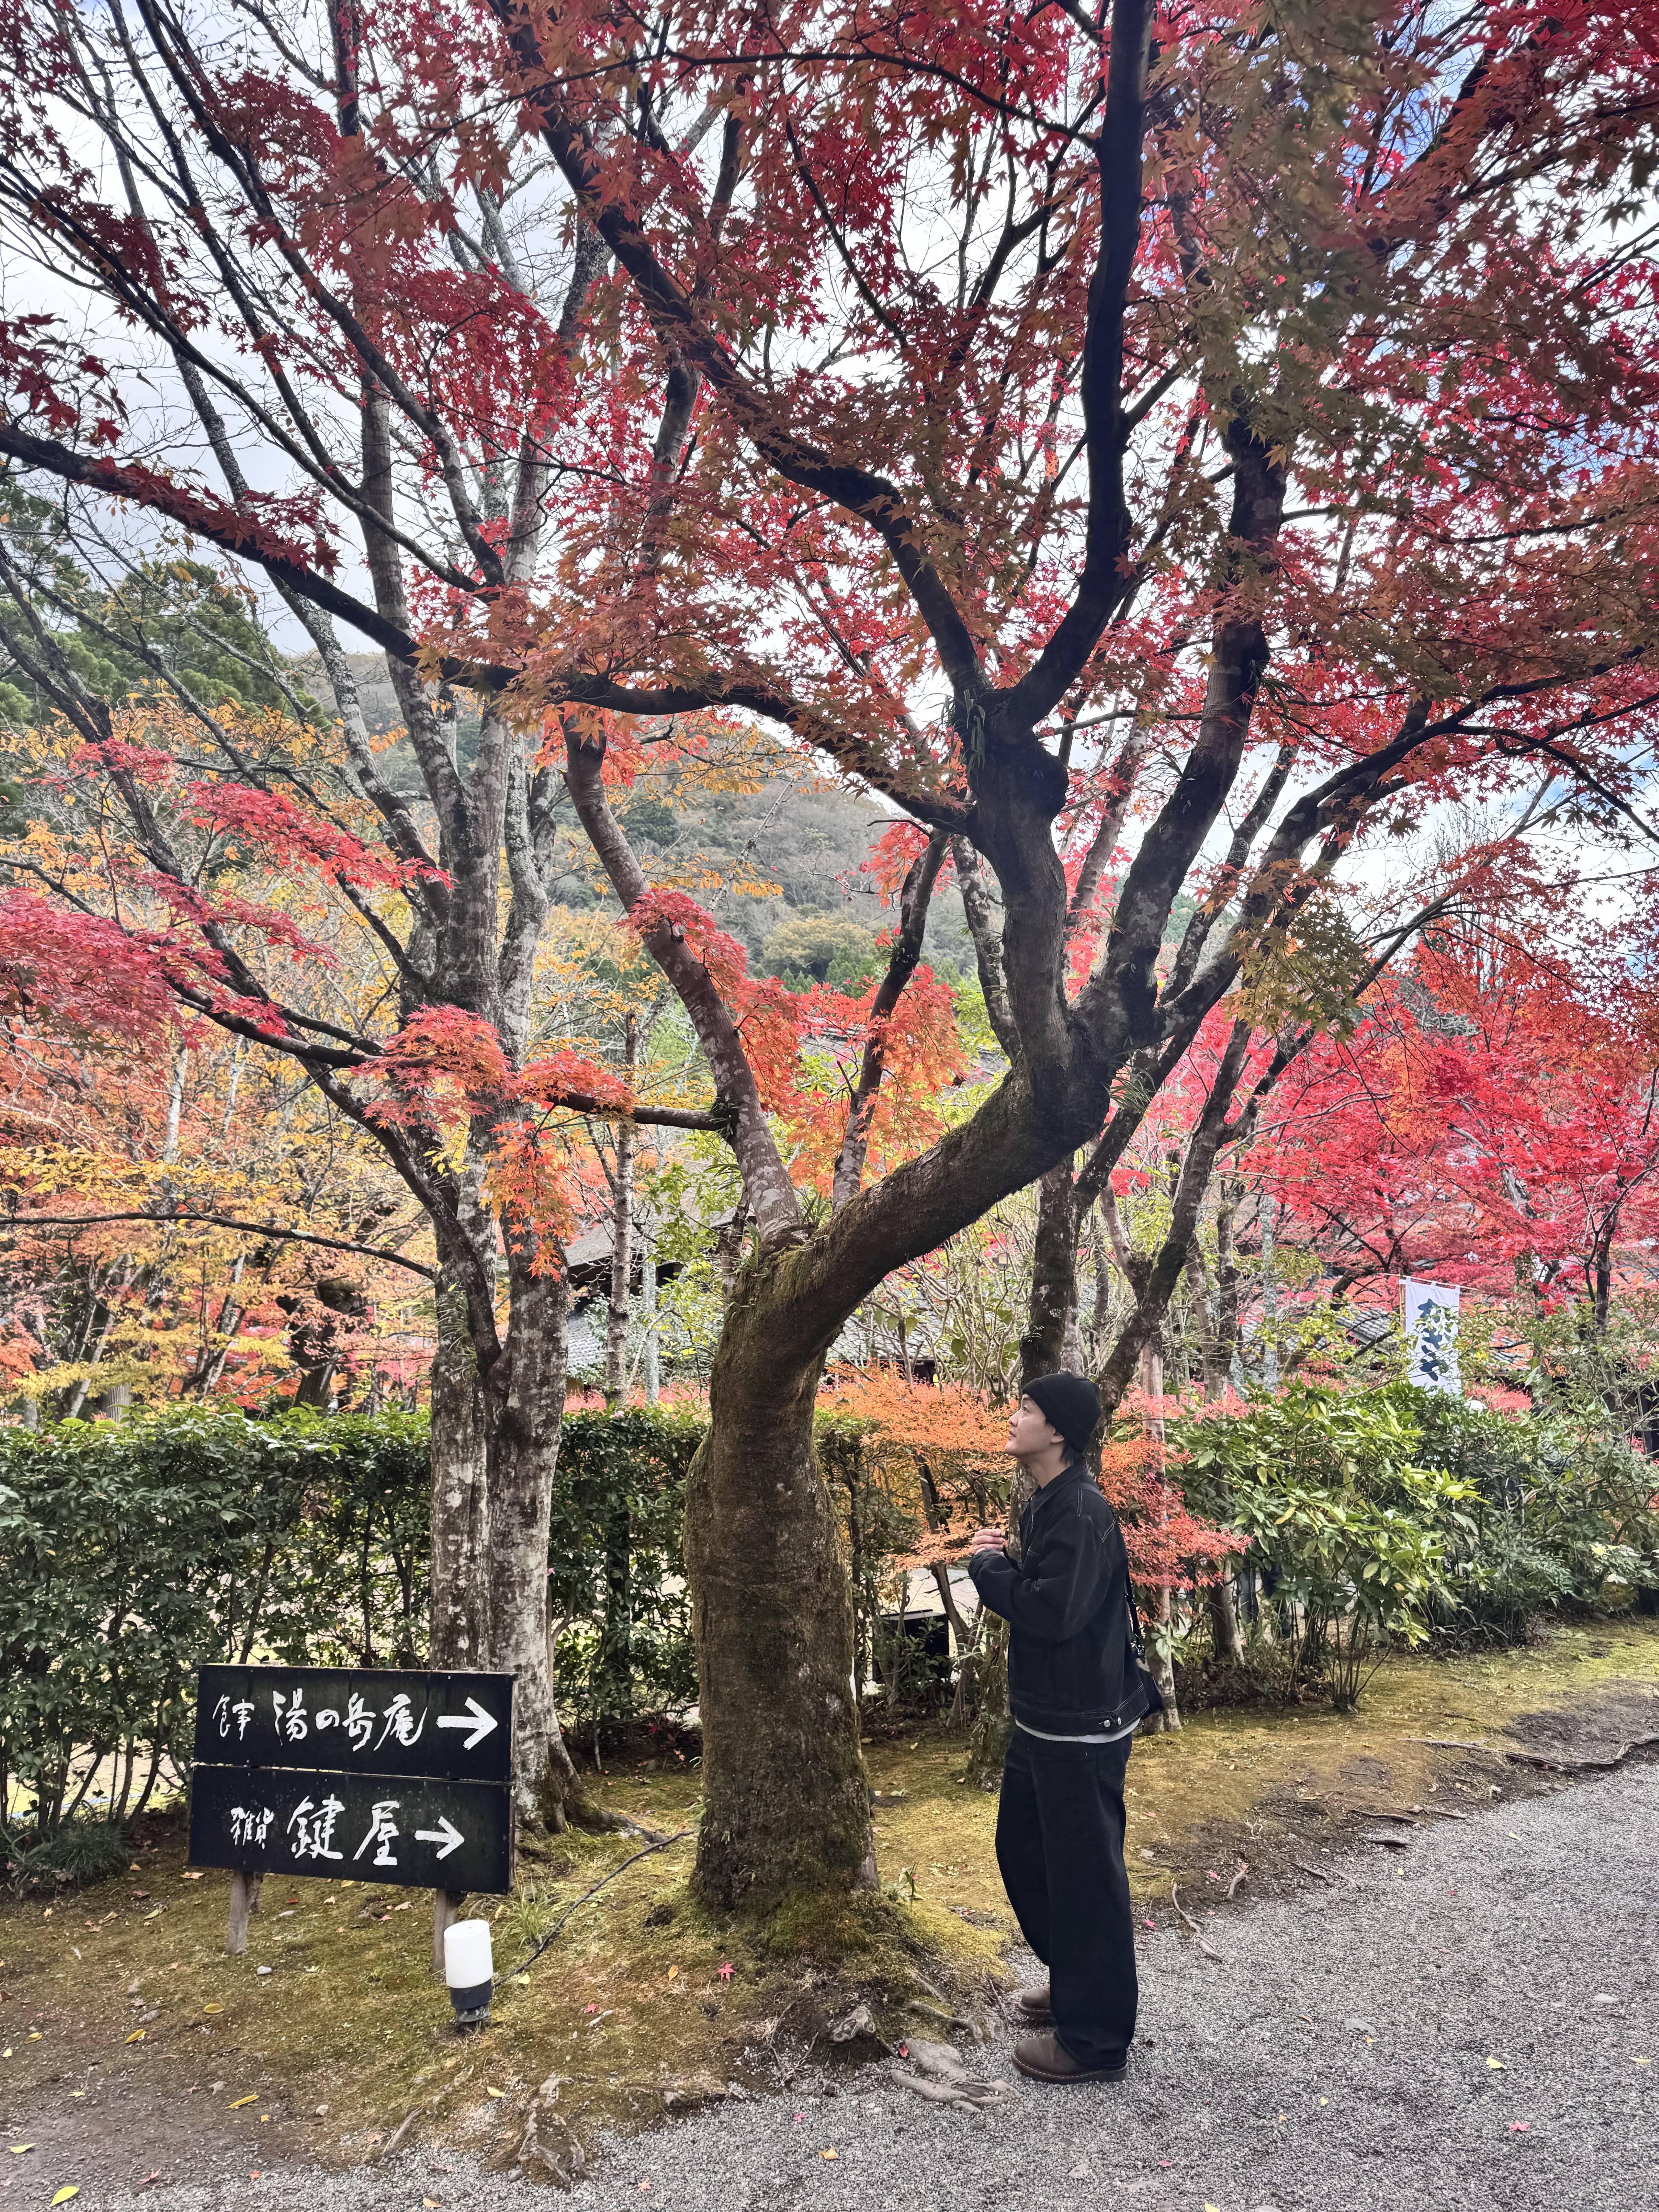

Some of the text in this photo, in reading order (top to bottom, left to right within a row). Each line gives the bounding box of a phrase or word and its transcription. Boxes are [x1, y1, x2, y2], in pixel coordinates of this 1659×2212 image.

[213, 1688, 427, 1752] 食事 湯の岳庵
[230, 1793, 400, 1865] 雑貨 鍵屋
